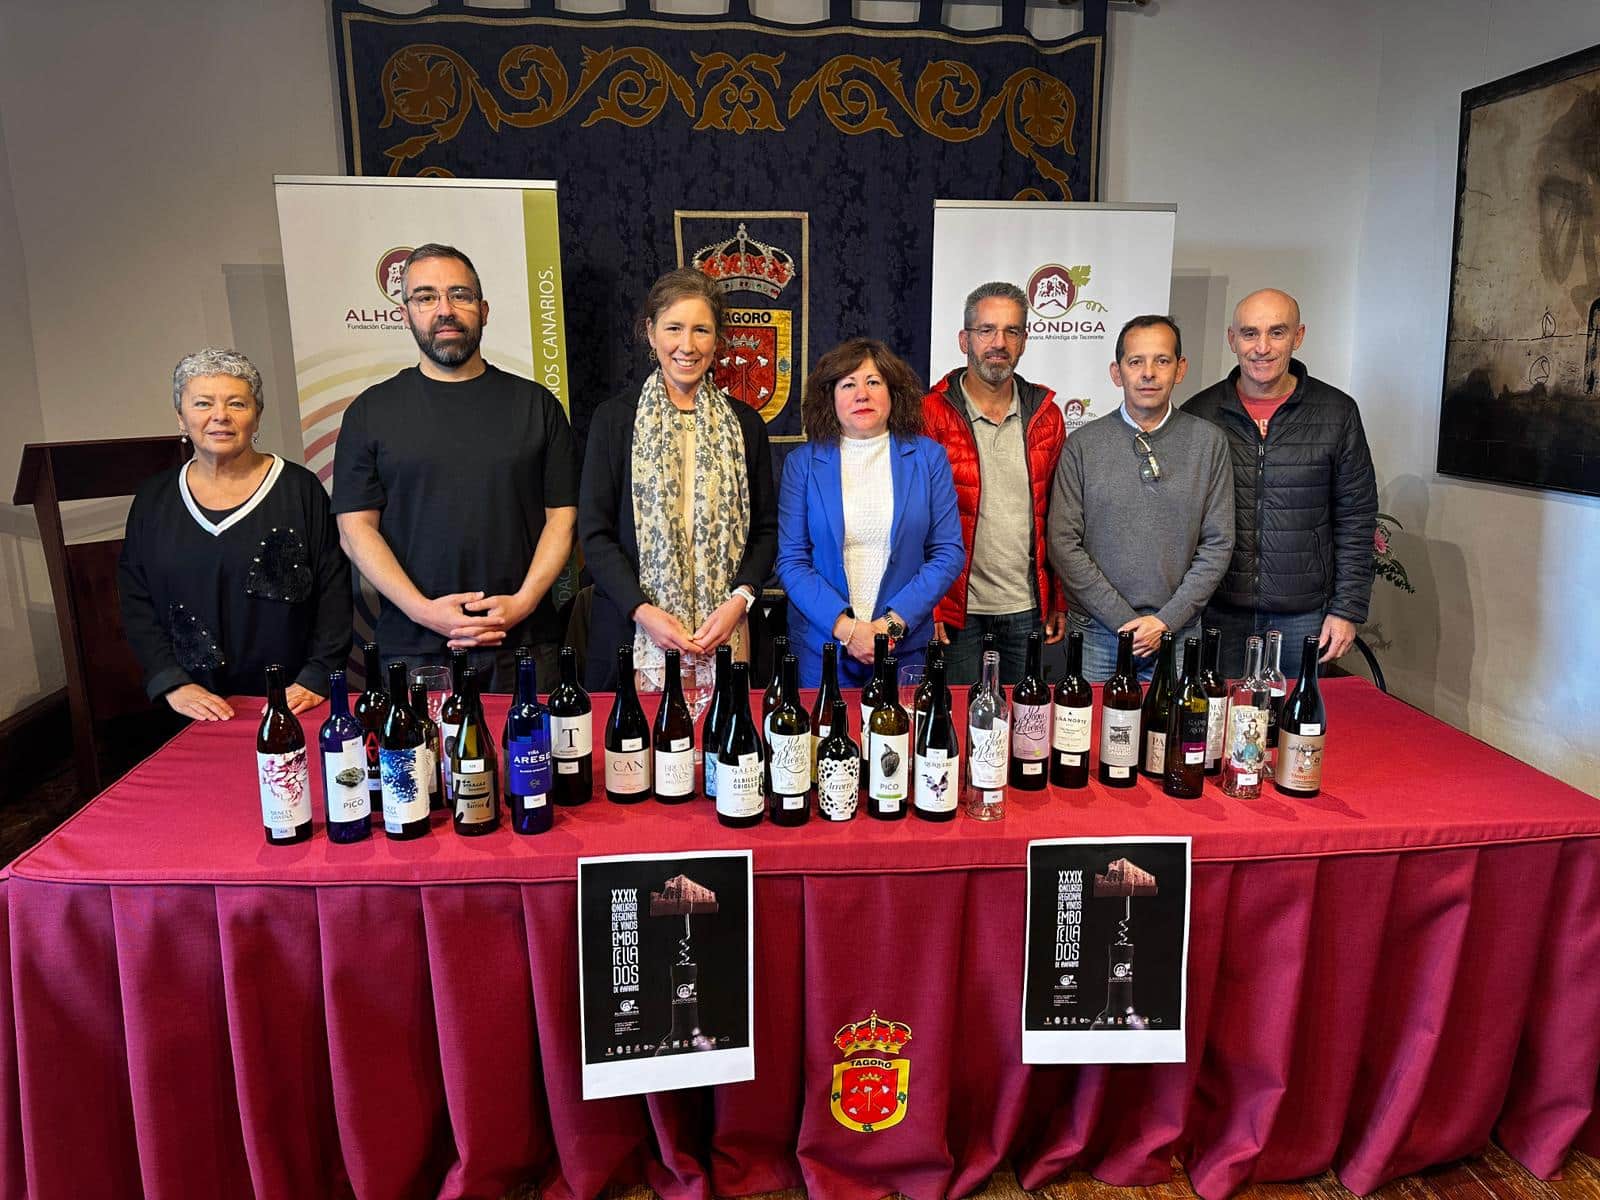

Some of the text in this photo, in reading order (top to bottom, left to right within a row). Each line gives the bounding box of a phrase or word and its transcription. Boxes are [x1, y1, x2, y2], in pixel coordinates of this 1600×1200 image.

[538, 265, 558, 360] CANARIOS.
[562, 727, 580, 748] T
[880, 783, 900, 791] PICO
[343, 798, 365, 809] PICO
[1058, 870, 1083, 884] XXXIX
[611, 888, 638, 903] XXXIX
[1057, 910, 1082, 925] EMBO
[612, 930, 639, 947] EMBO
[1056, 925, 1081, 943] TELLA
[612, 946, 639, 965] TELLA
[1055, 942, 1080, 961] DOS
[613, 965, 640, 986] DOS
[851, 1058, 893, 1069] TAGORO
